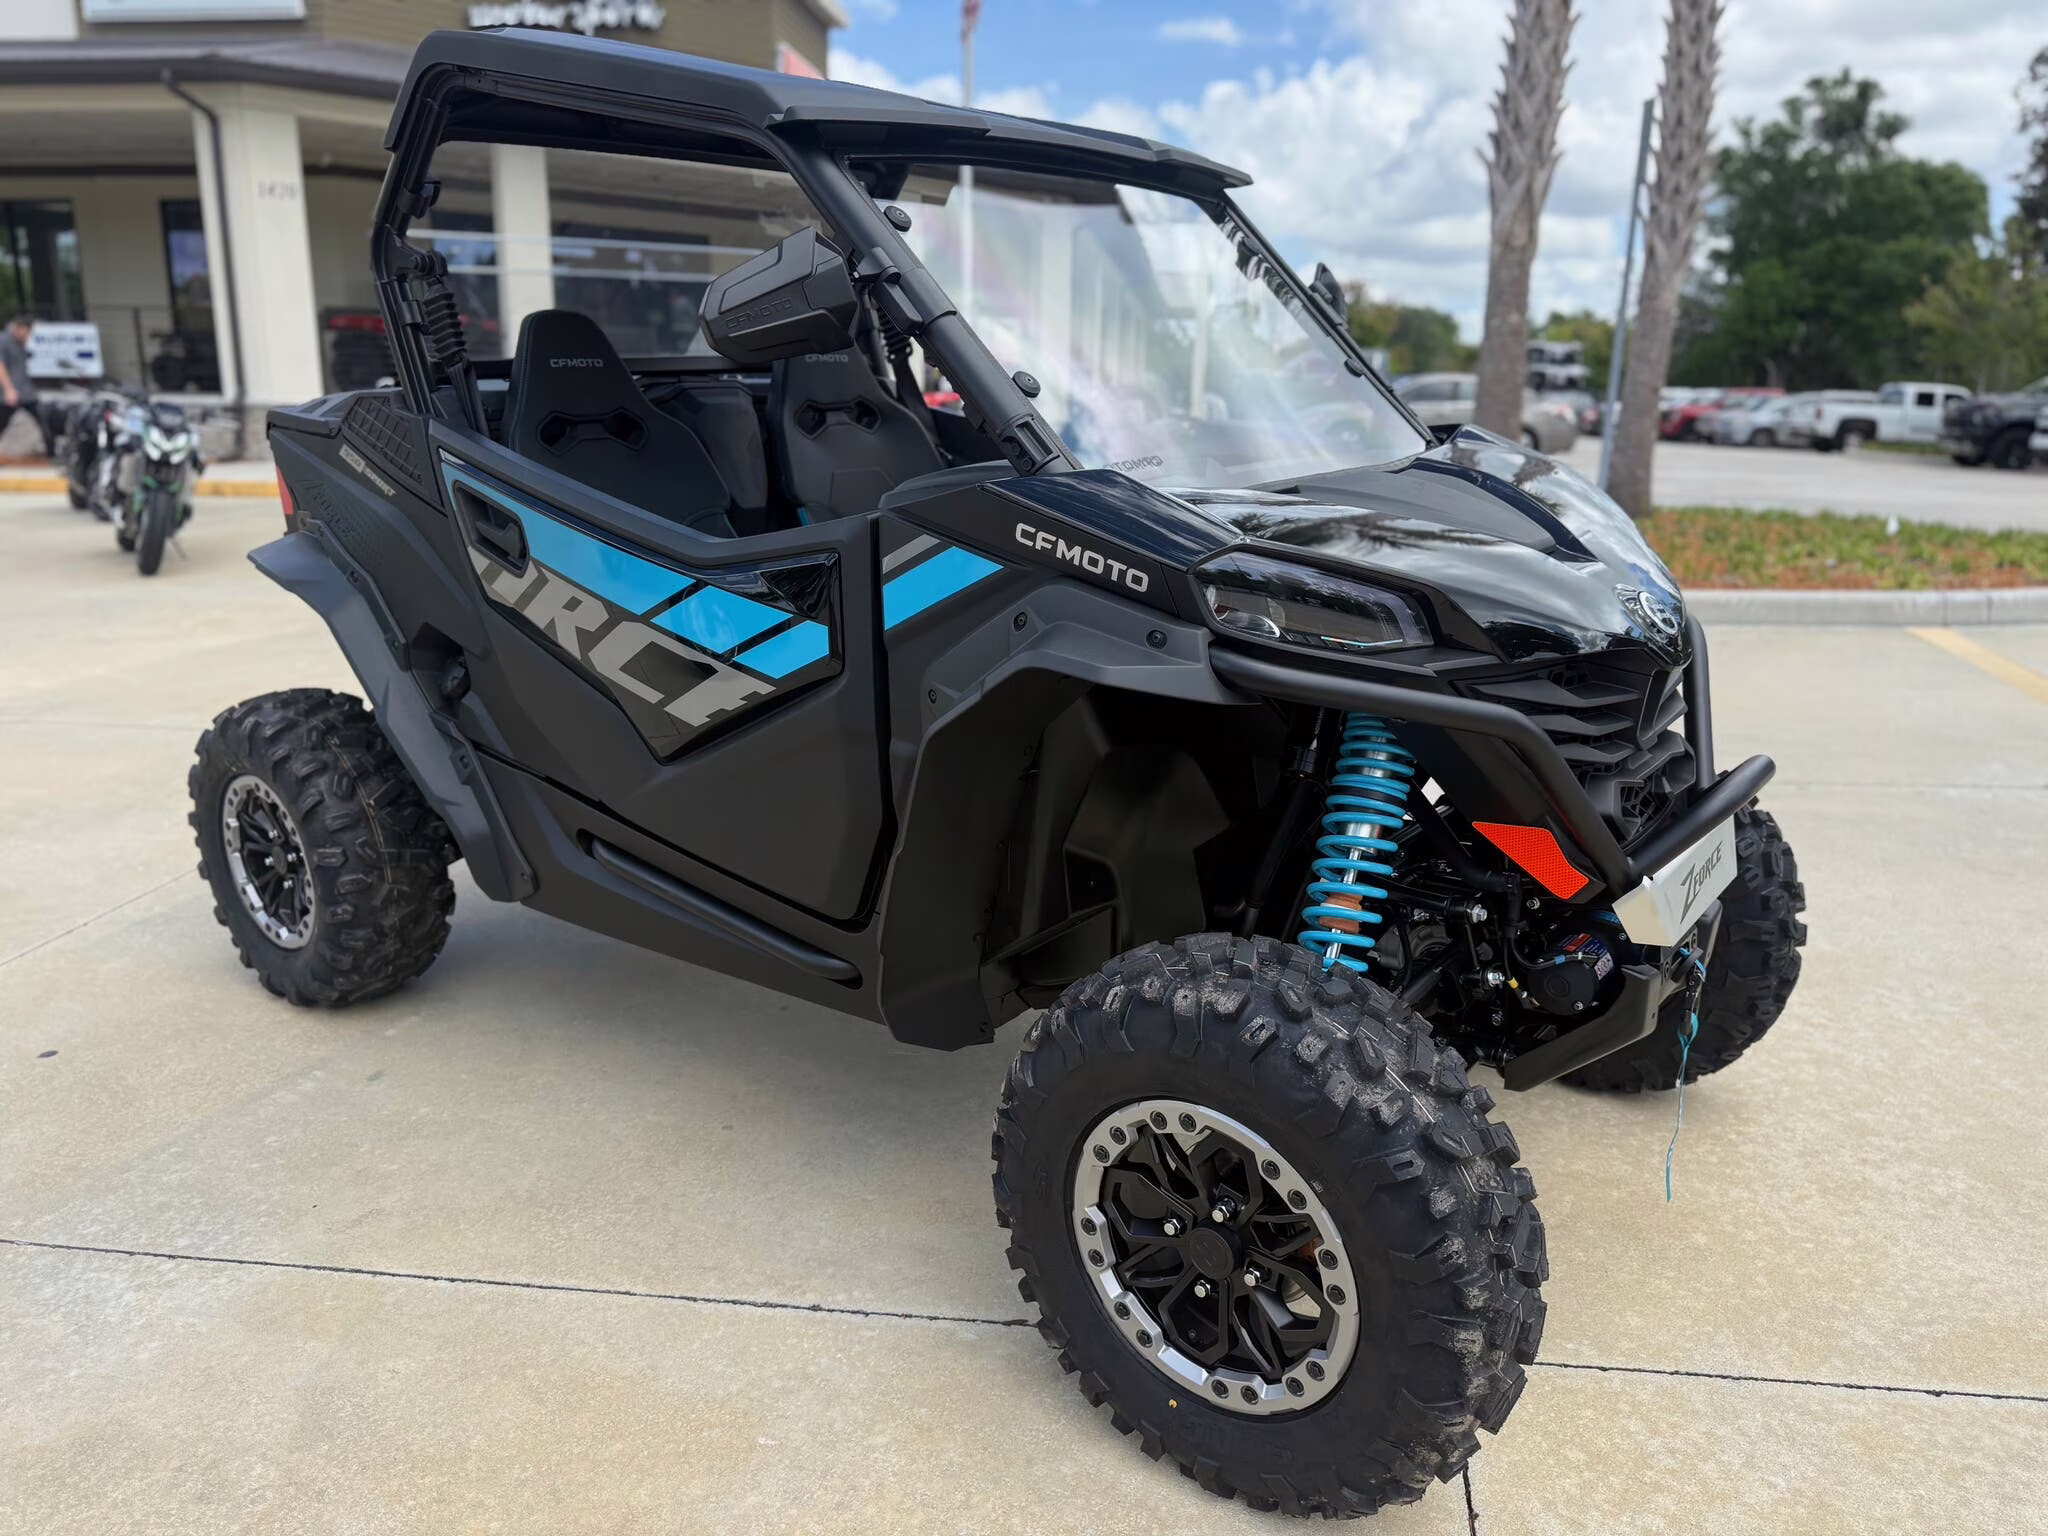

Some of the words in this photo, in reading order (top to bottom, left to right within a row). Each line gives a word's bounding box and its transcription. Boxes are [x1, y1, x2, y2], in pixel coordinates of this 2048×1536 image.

[550, 358, 604, 368] CFMOTO
[805, 354, 849, 362] CFMOTO
[1015, 522, 1149, 593] CFMOTO
[1680, 840, 1723, 925] ZFORCE
